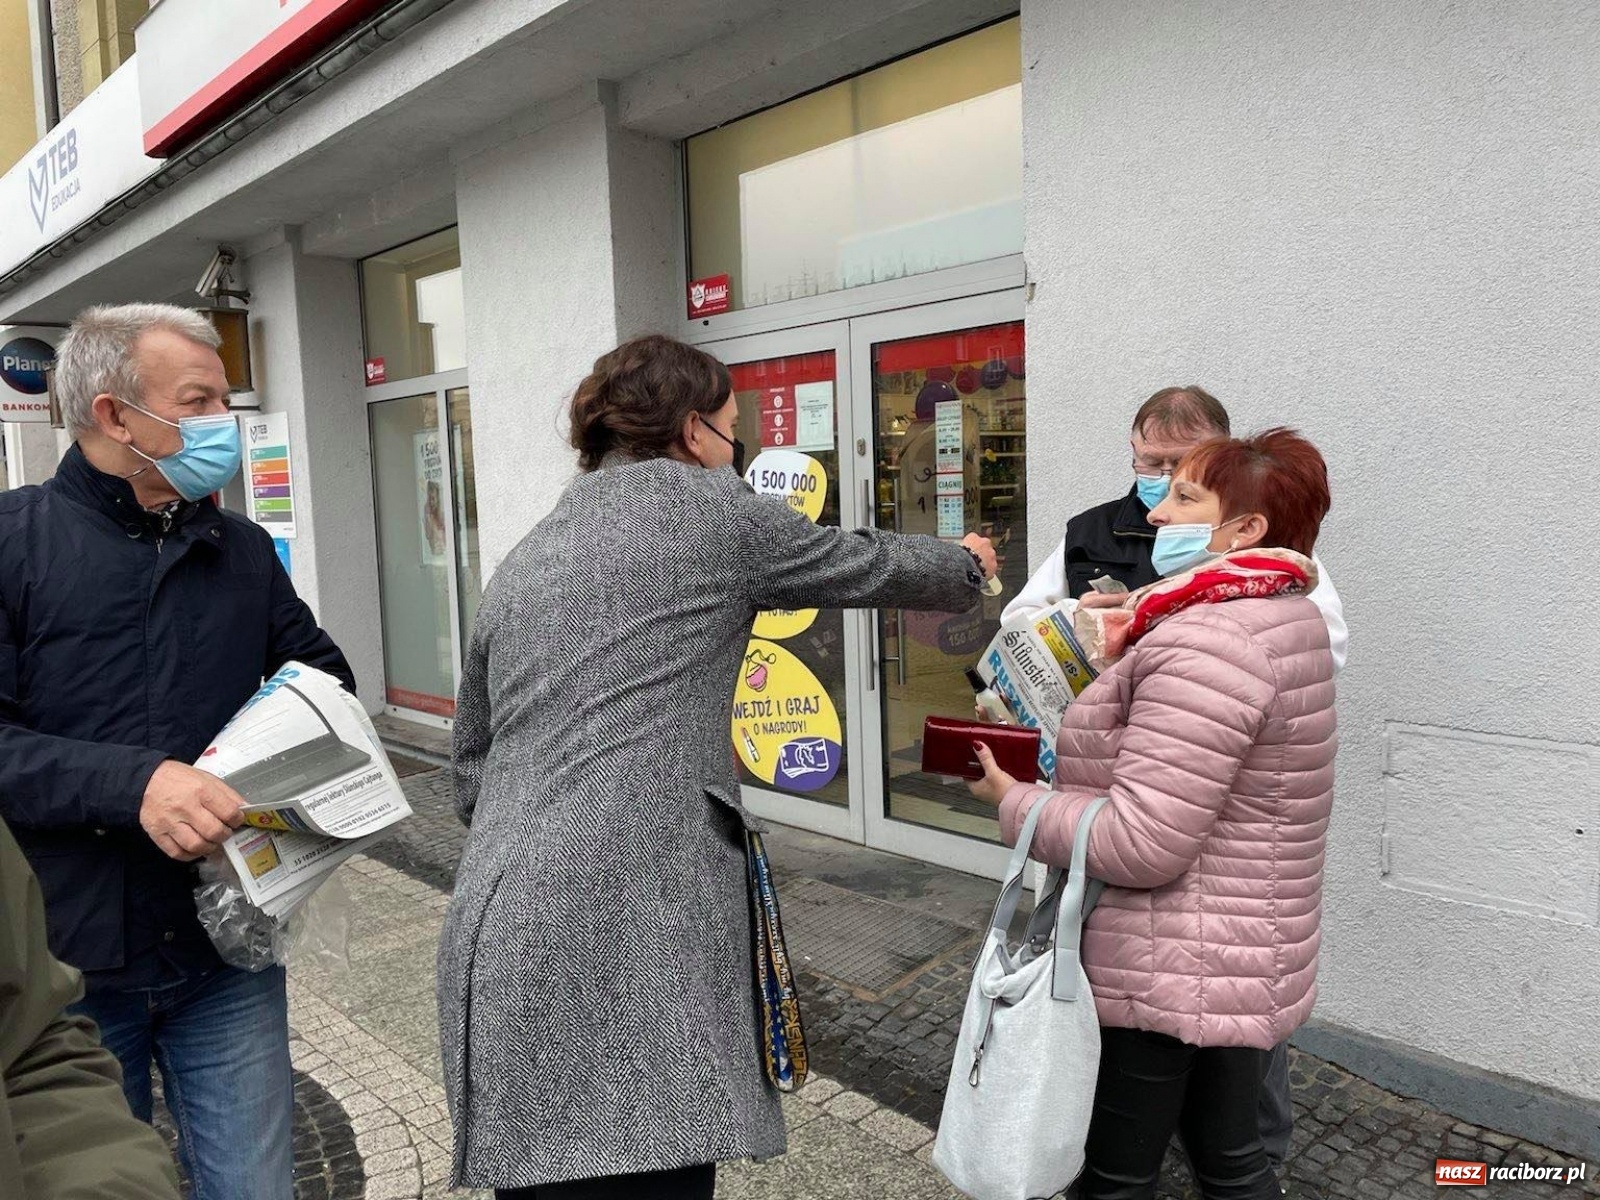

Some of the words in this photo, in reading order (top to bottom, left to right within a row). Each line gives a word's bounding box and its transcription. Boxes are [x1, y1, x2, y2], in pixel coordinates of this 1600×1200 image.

[48, 127, 78, 185] TEB
[51, 178, 81, 211] EDUKACJA
[3, 356, 51, 372] Plane
[2, 403, 51, 411] BANKOM
[750, 469, 756, 487] 1
[761, 470, 786, 490] 500
[791, 472, 817, 493] 000
[733, 696, 773, 719] WEJDŹ
[777, 700, 782, 716] I
[786, 695, 820, 716] GRAJ
[753, 723, 760, 736] O
[763, 720, 807, 735] NAGRODY!
